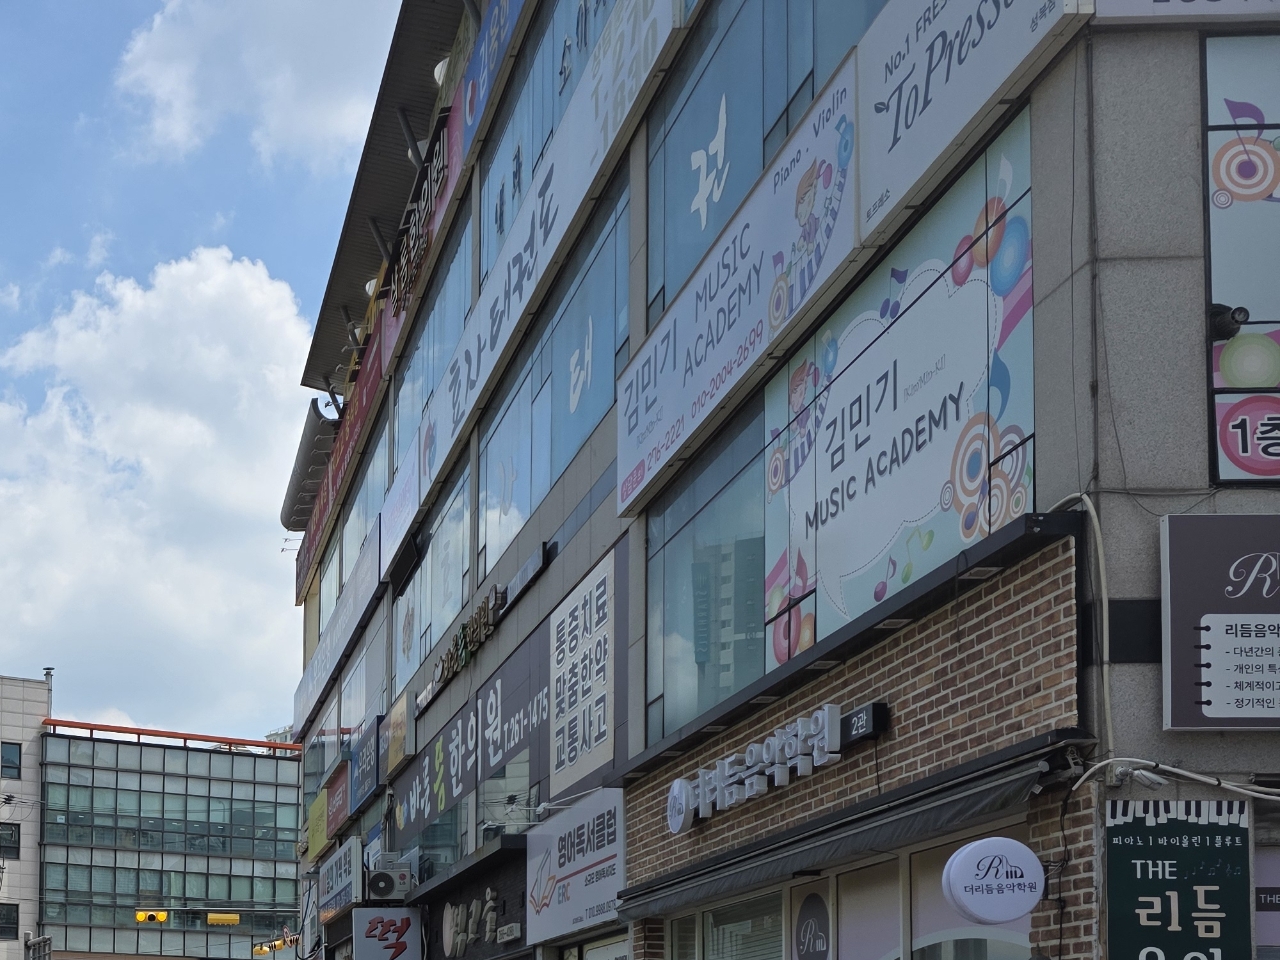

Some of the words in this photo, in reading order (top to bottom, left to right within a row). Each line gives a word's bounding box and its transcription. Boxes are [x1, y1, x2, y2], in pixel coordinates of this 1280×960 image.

[773, 150, 801, 194] Piano
[813, 87, 847, 138] Violin
[695, 222, 751, 323] MUSIC
[683, 250, 764, 389] ACADEMY
[624, 317, 677, 437] 김민기
[647, 414, 684, 472] 276-2221
[691, 319, 764, 419] 010-2004-2699
[825, 358, 897, 473] 김민기
[805, 475, 857, 540] MUSIC
[864, 381, 964, 494] ACADEMY
[555, 572, 608, 669] 통증치료
[1233, 646, 1274, 658] 다년간의
[555, 630, 609, 723] 맞춤한약
[1233, 663, 1265, 675] 개인의
[1234, 697, 1275, 709] 정기적인
[504, 685, 549, 754] T.261-1475
[554, 690, 608, 774] 교통사고
[690, 704, 841, 818] 더리듬음악학원
[851, 711, 867, 735] 2관
[558, 806, 616, 868] 영어독서클럽
[1112, 836, 1144, 846] 피아노
[1158, 835, 1201, 847] 바이올린
[1214, 836, 1243, 847] 플루트
[1131, 860, 1178, 880] THE
[558, 882, 570, 905] ERC
[963, 881, 1037, 896] 더리듬음악학원
[1134, 885, 1226, 938] 리듬
